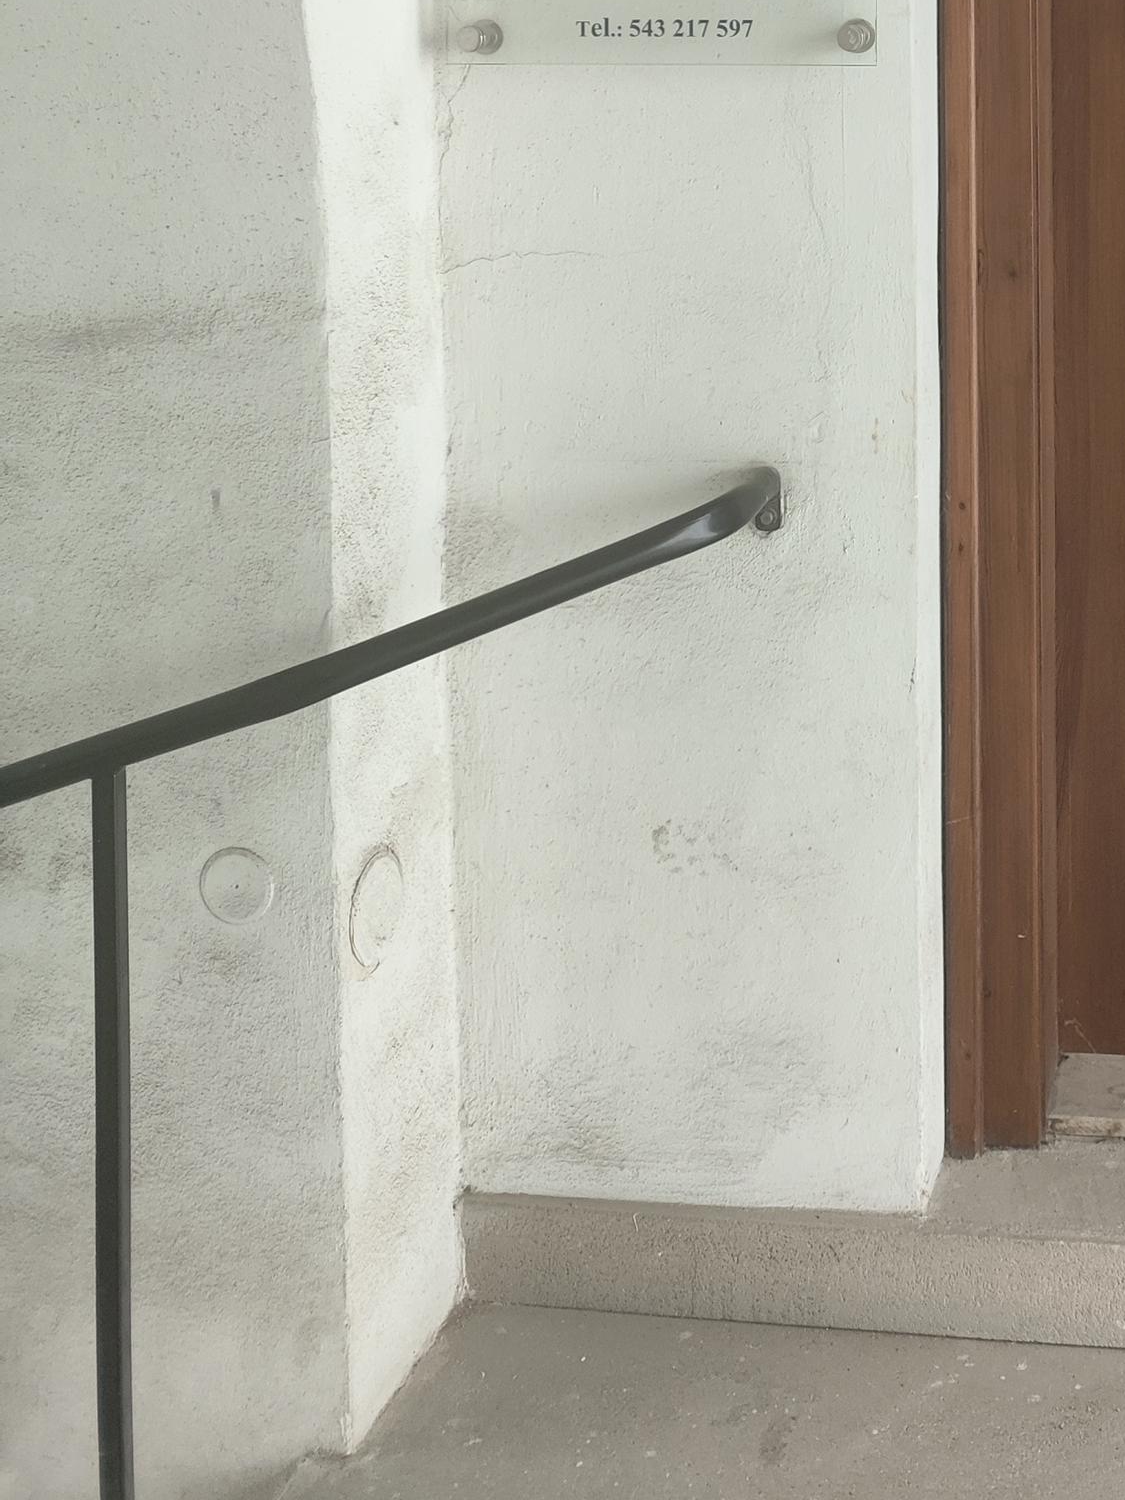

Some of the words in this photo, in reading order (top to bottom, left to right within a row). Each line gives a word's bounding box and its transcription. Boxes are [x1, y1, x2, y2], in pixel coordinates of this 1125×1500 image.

[575, 18, 622, 38] Tel.:
[629, 20, 665, 38] 543
[672, 20, 710, 38] 217
[716, 20, 754, 38] 597
